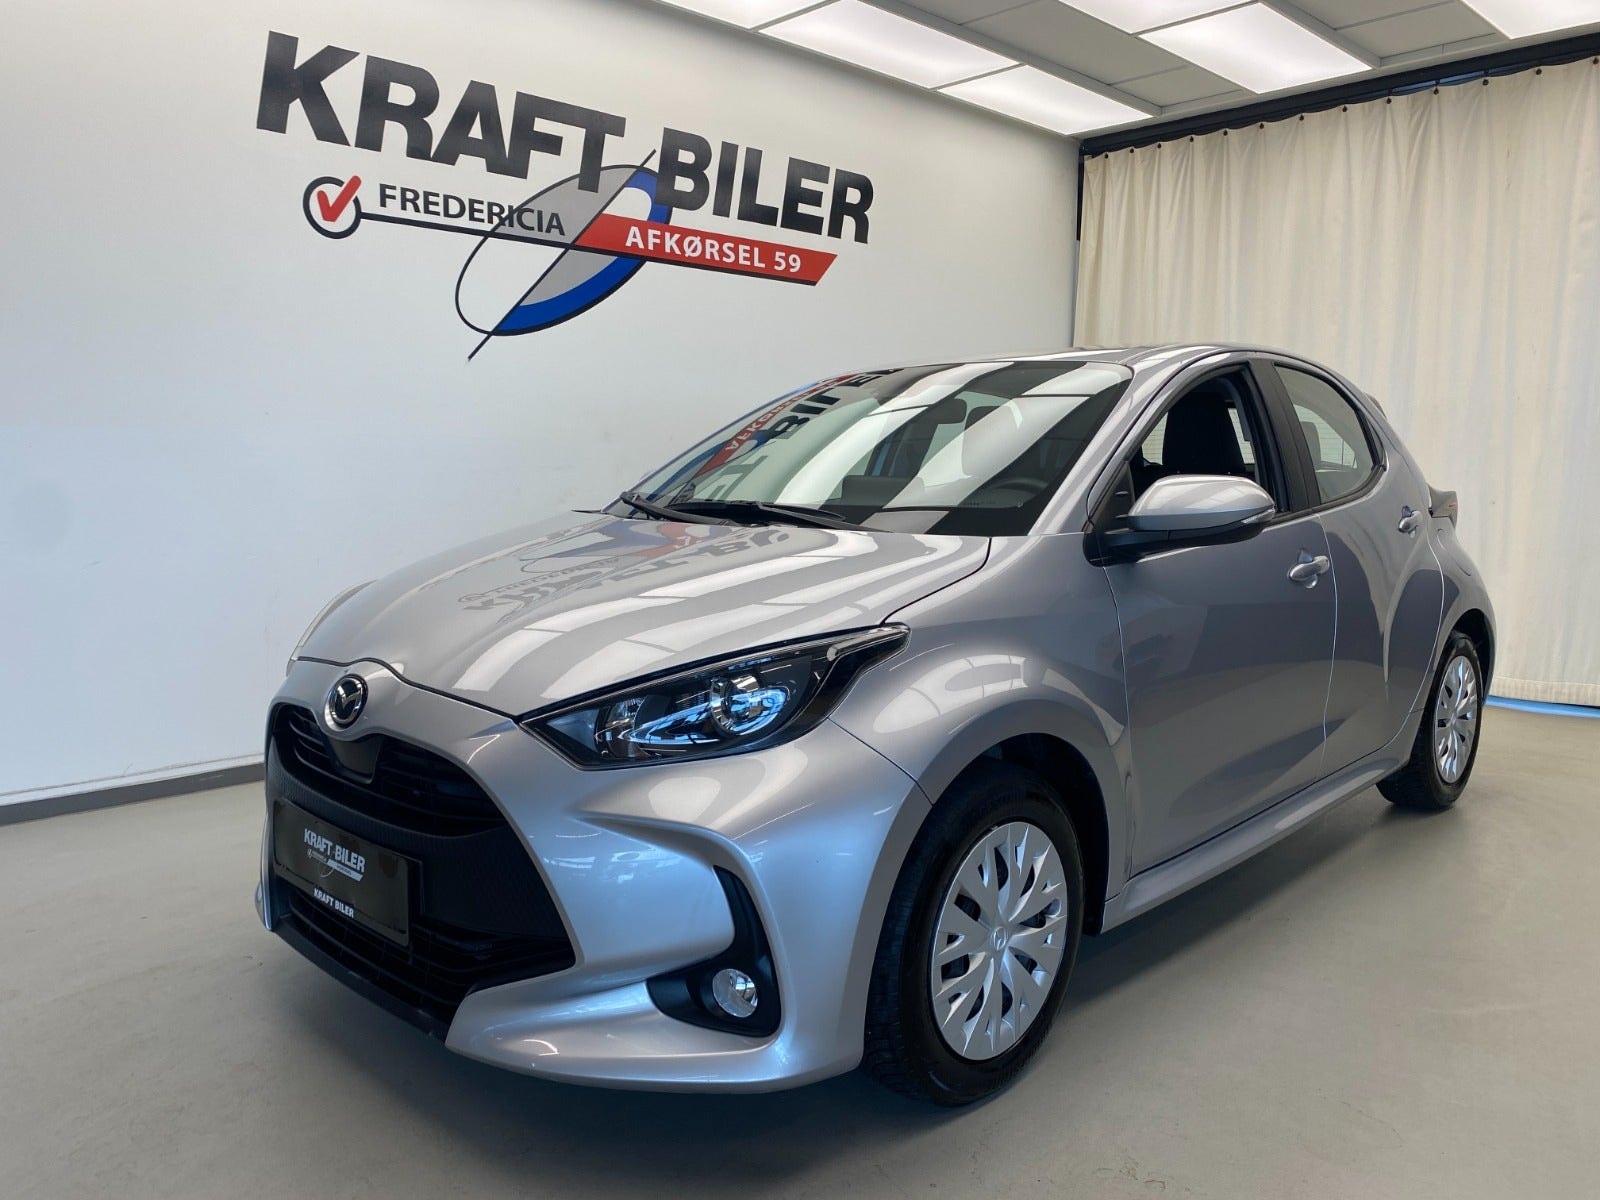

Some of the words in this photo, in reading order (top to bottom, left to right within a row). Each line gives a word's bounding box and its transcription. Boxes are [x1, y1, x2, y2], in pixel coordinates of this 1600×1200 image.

[256, 30, 627, 194] KRAFT
[656, 127, 875, 244] BILER
[379, 183, 566, 237] FREDERICIA
[625, 225, 766, 269] AFKØRSEL
[773, 251, 801, 273] 59
[303, 828, 333, 856] KRAFT
[334, 844, 366, 873] BILER
[313, 887, 334, 907] KRAFT
[334, 899, 354, 918] BILER
